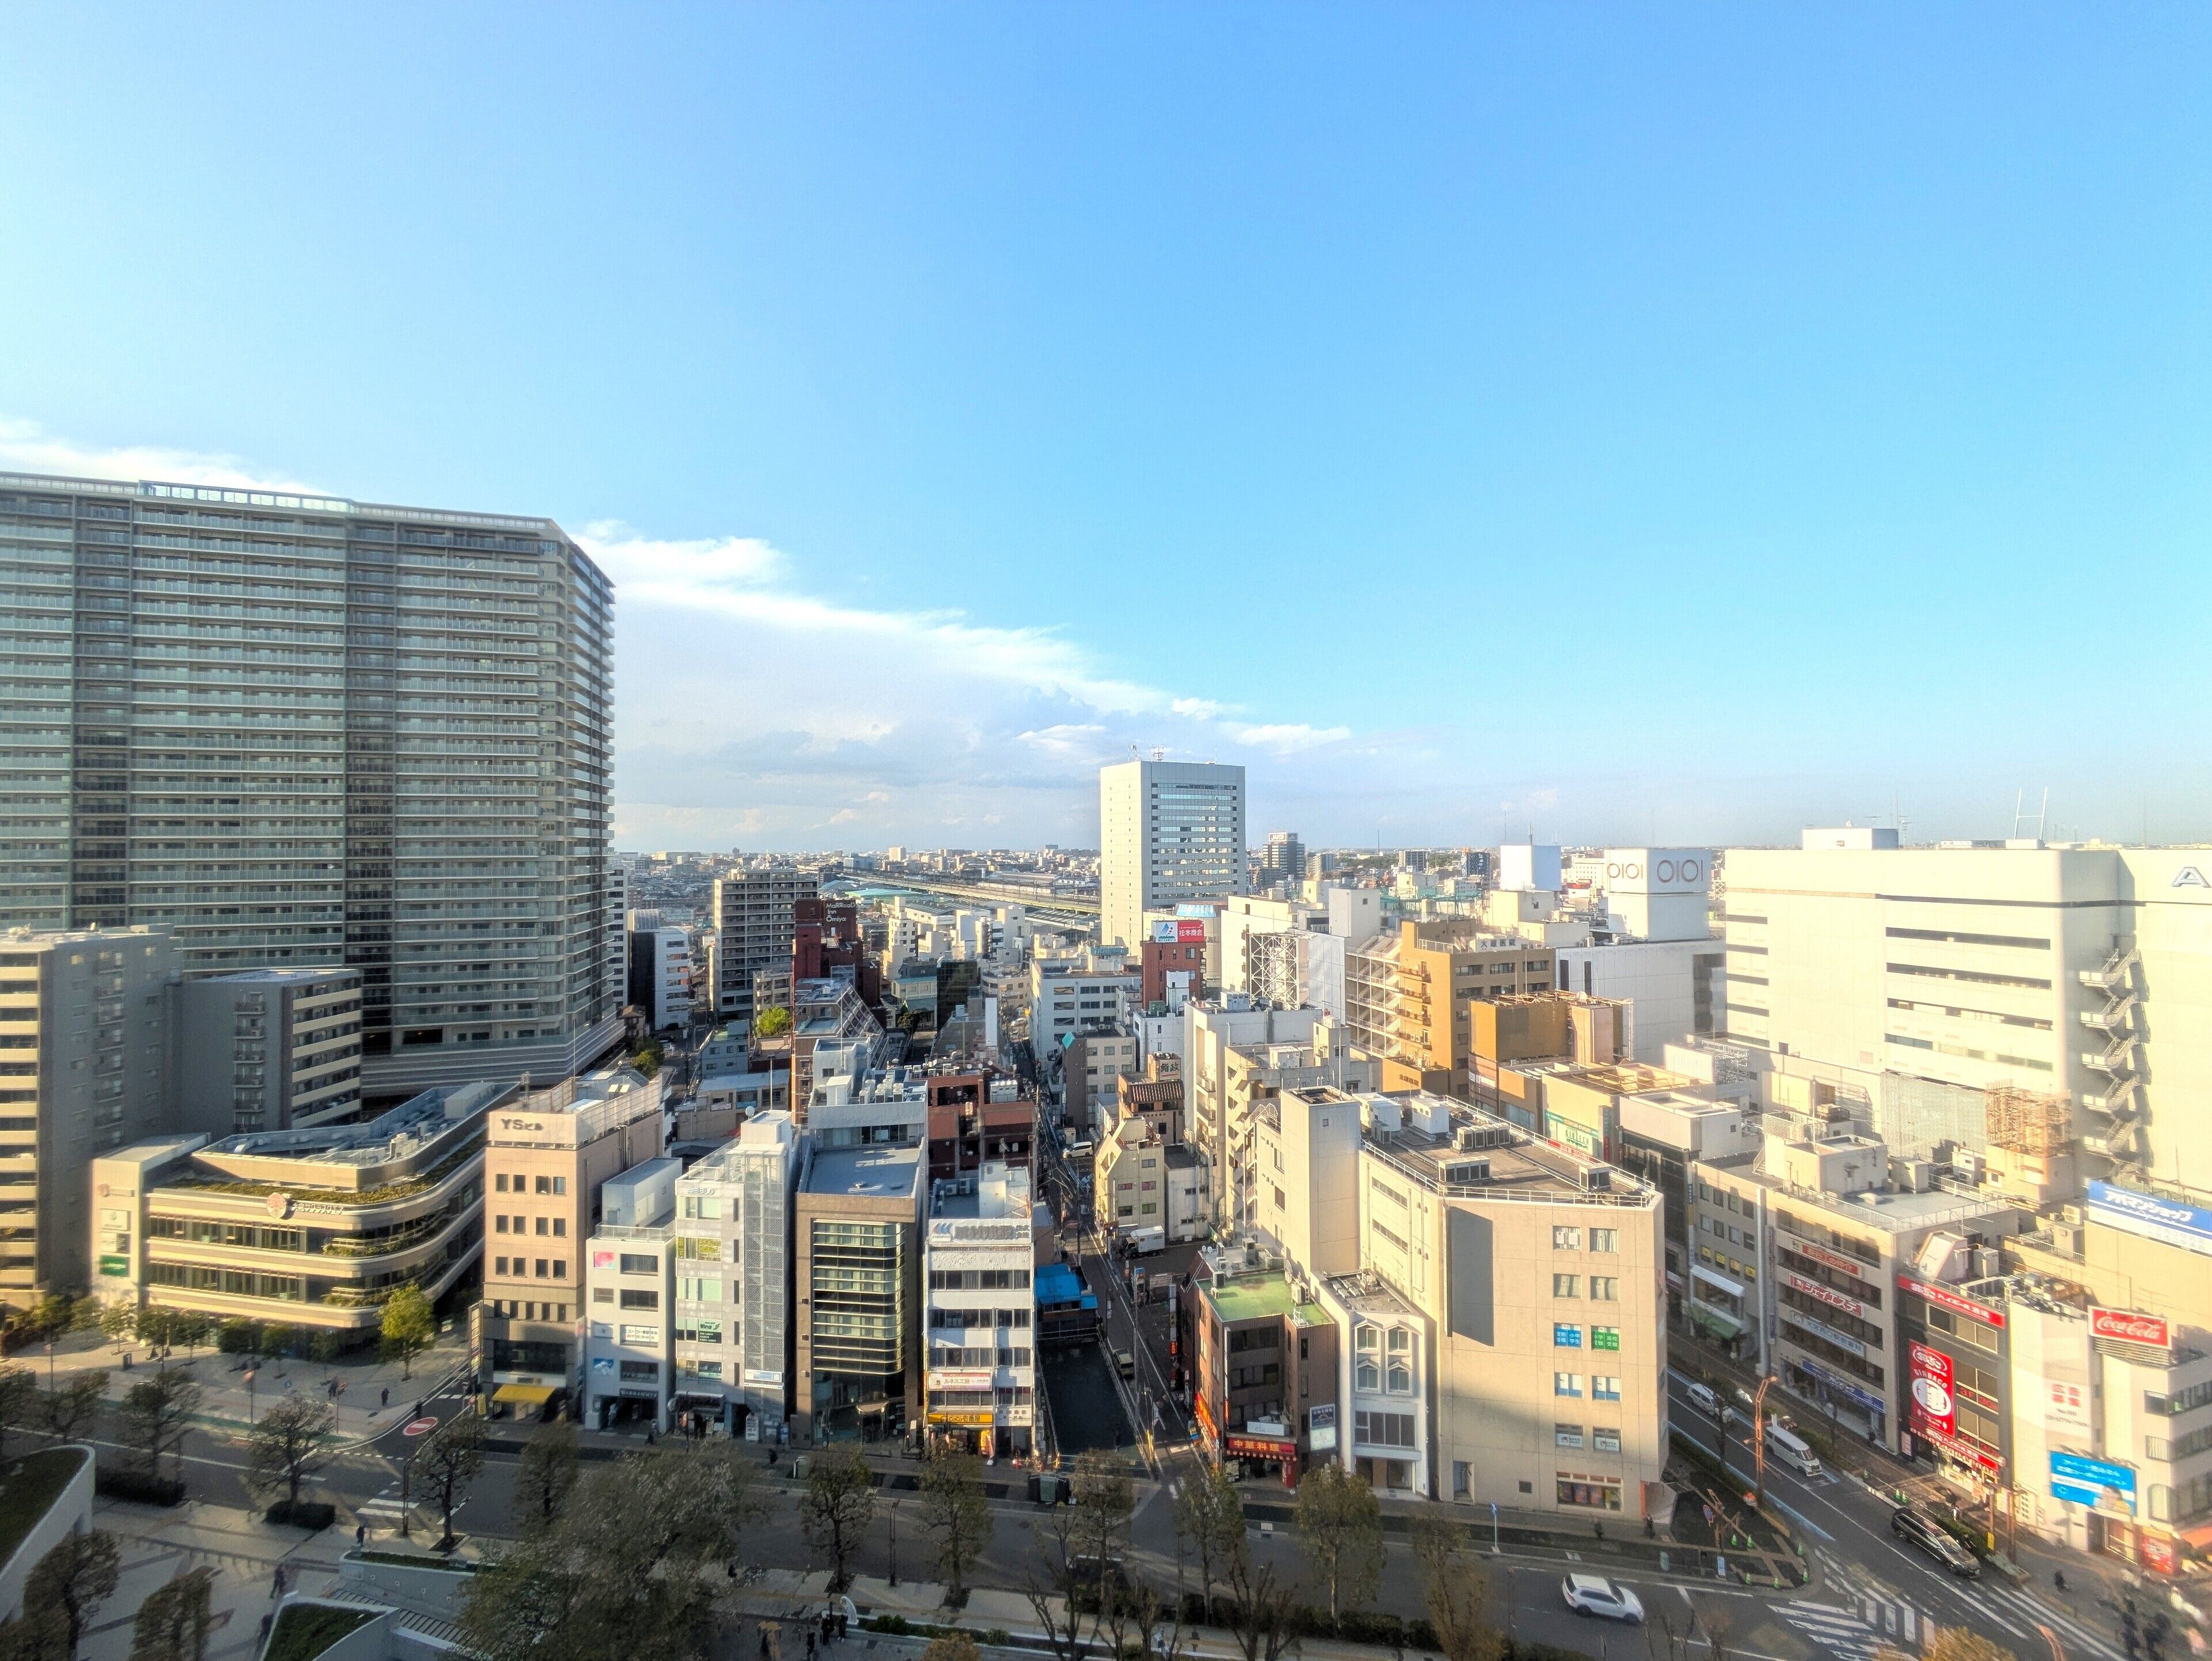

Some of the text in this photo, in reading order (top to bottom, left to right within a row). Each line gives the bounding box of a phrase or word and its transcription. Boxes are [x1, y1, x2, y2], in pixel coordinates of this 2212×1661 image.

[501, 1119, 544, 1131] YSビル
[1804, 1282, 1858, 1312] ジェイエステ
[2097, 1316, 2163, 1339] Coca-Cola
[1234, 1439, 1279, 1452] 中華料理
